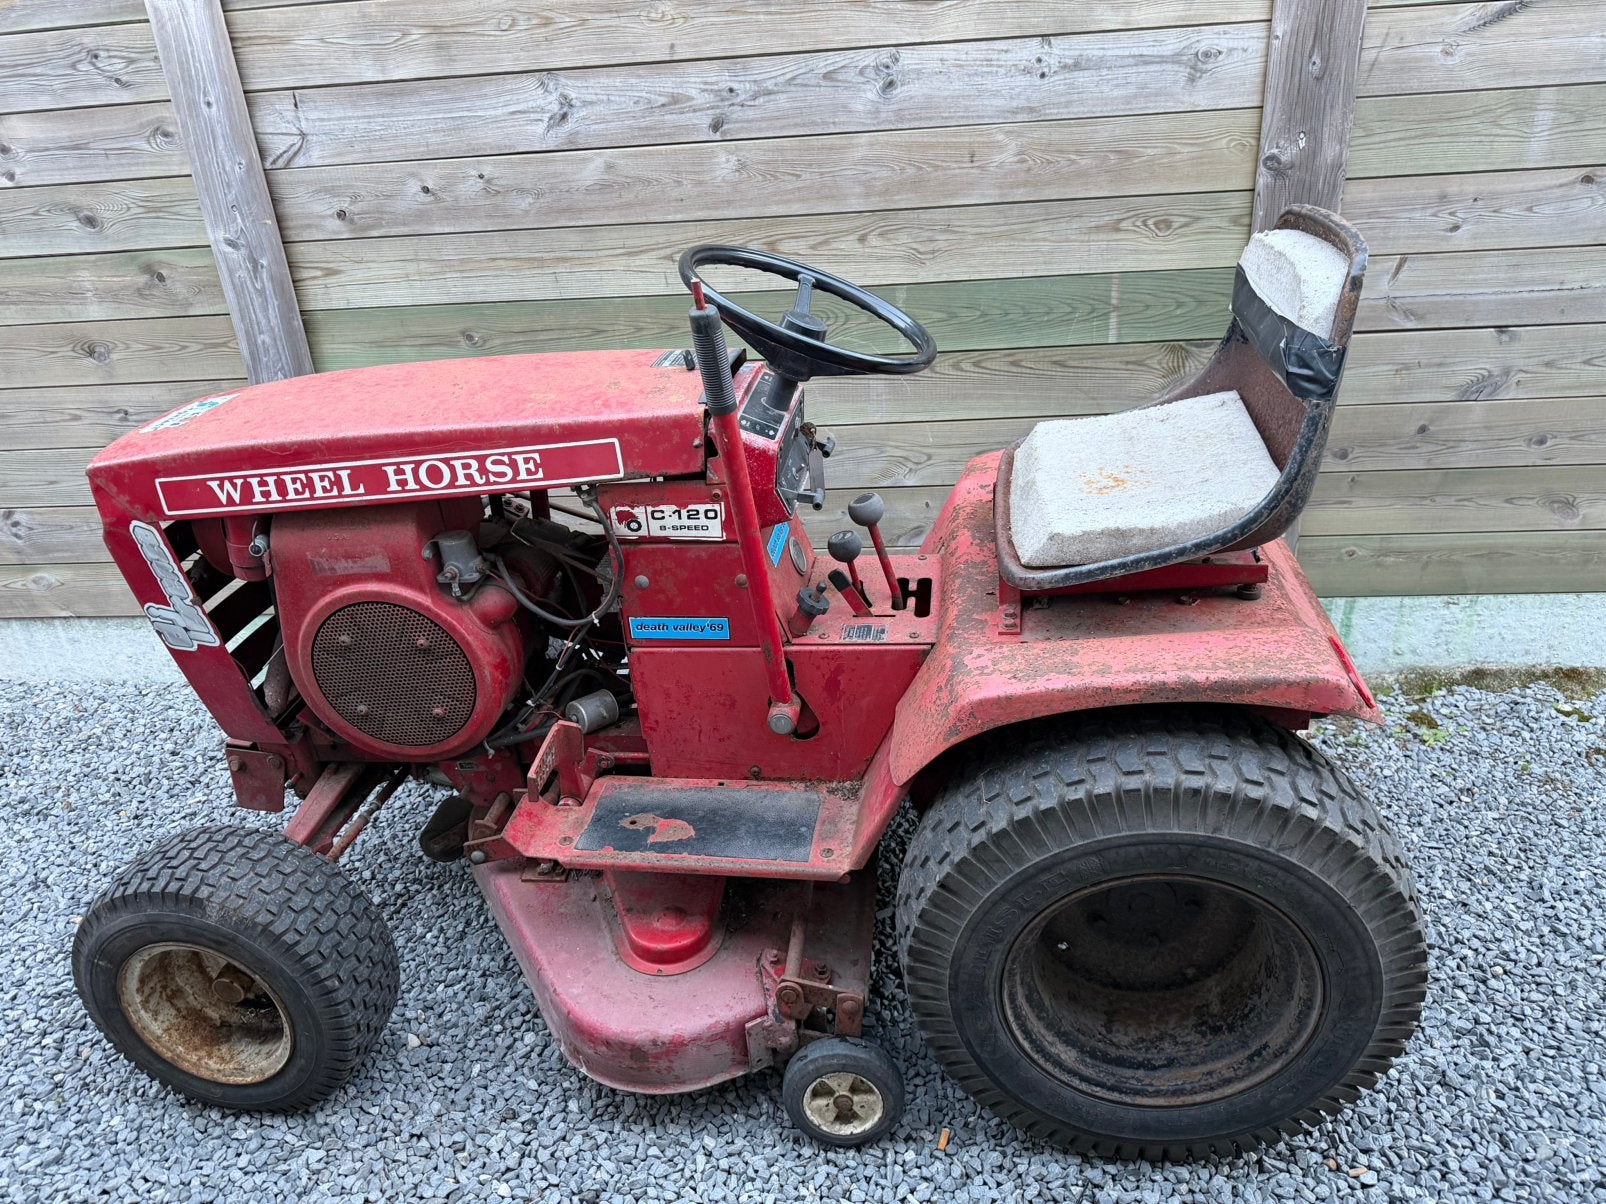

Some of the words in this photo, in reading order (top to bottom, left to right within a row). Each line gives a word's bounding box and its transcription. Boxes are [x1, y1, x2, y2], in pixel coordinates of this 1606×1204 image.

[206, 469, 365, 505] WHEEL
[381, 452, 544, 492] HORSE
[636, 623, 669, 632] death
